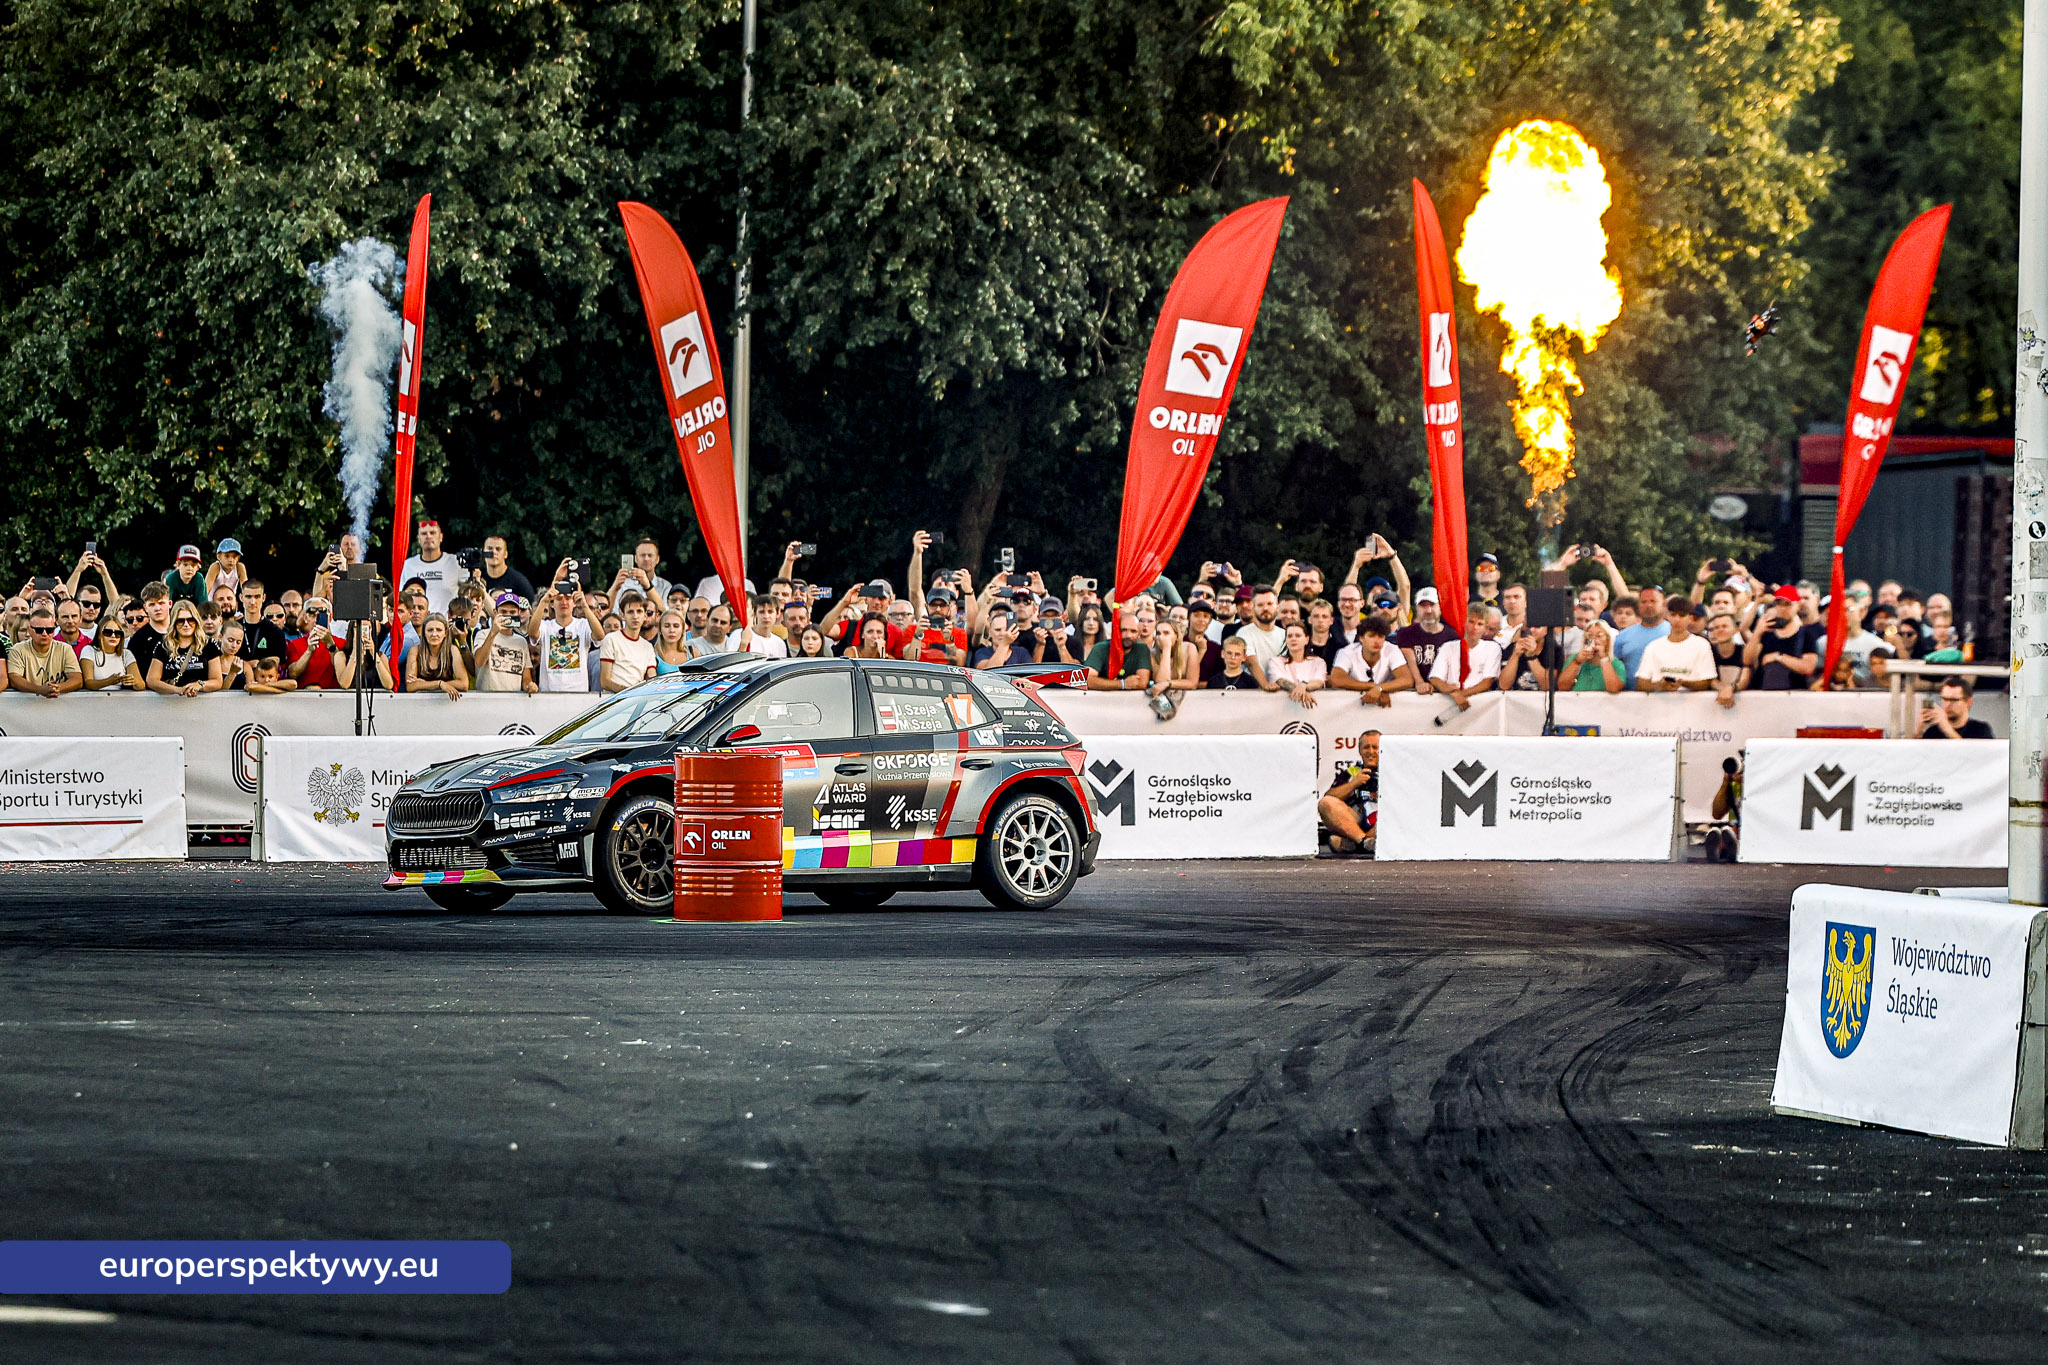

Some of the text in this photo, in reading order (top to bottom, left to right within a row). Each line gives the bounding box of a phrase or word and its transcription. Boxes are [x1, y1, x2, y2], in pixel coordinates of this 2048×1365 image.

[1172, 438, 1195, 456] OIL
[944, 693, 974, 726] 17
[874, 752, 950, 769] GKFORGE
[877, 772, 902, 781] Kuźnia
[1148, 774, 1232, 789] Górnośląsko
[1510, 776, 1592, 791] Górnośląsko
[832, 783, 866, 793] ATLAS
[1868, 781, 1945, 796] Górnośląsko
[0, 789, 143, 811] portu i Turystyki
[832, 794, 867, 804] WARD
[1149, 789, 1252, 805] -Zagłębiowska
[1510, 792, 1612, 807] -Zagłębiowska
[904, 809, 937, 822] KSSE
[1149, 806, 1223, 821] Metropolia
[1510, 808, 1582, 823] Metropolia
[1866, 814, 1935, 829] Metropolia
[711, 830, 750, 840] ORLEN
[711, 841, 727, 850] OIL
[1891, 936, 1991, 979] Województwo
[1887, 978, 1938, 1023] Śląskie
